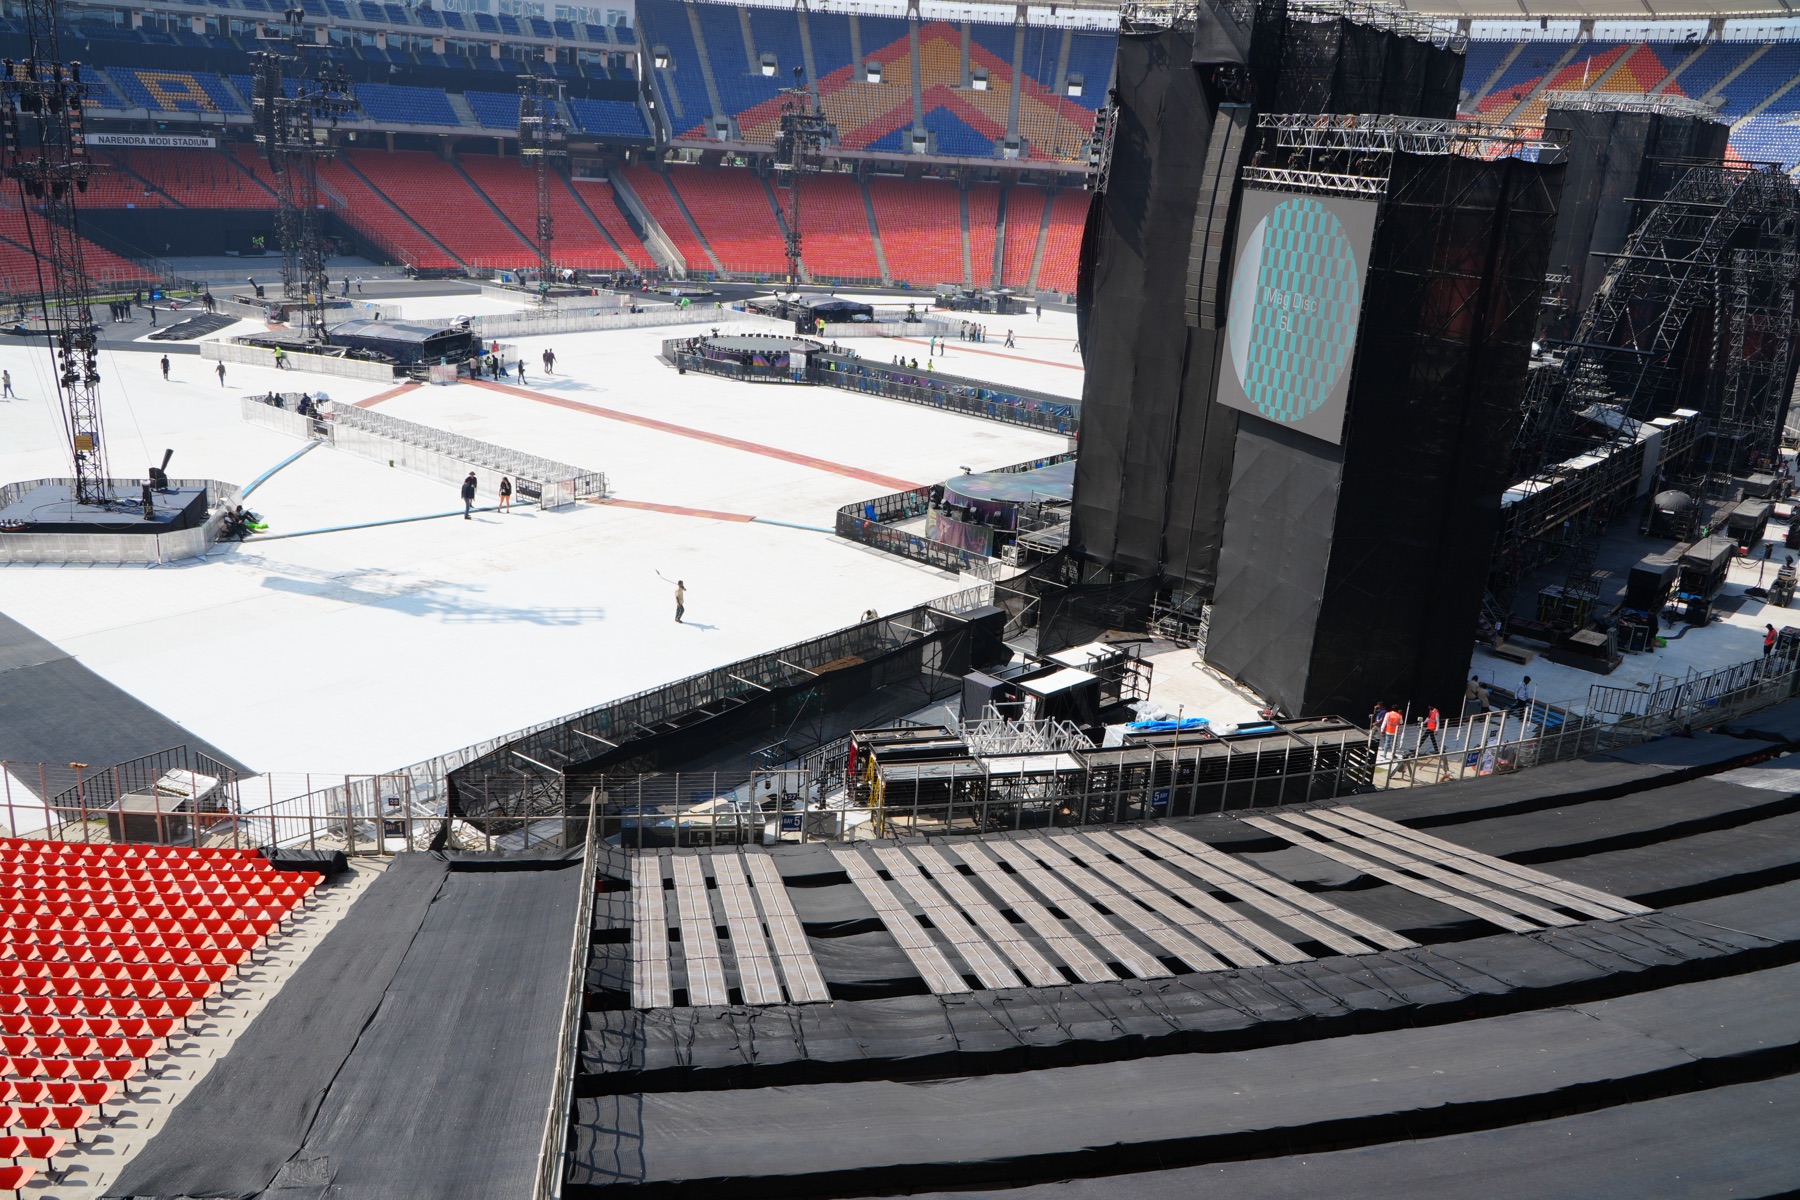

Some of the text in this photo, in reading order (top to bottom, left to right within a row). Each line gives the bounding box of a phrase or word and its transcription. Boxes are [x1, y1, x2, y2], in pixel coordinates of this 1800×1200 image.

[98, 136, 209, 147] NARENDRA MODI STADIUM
[1264, 287, 1317, 312] iMag Disc
[1280, 315, 1292, 332] SL
[1154, 792, 1160, 801] 5
[794, 816, 800, 826] 5
[397, 822, 402, 832] 1
